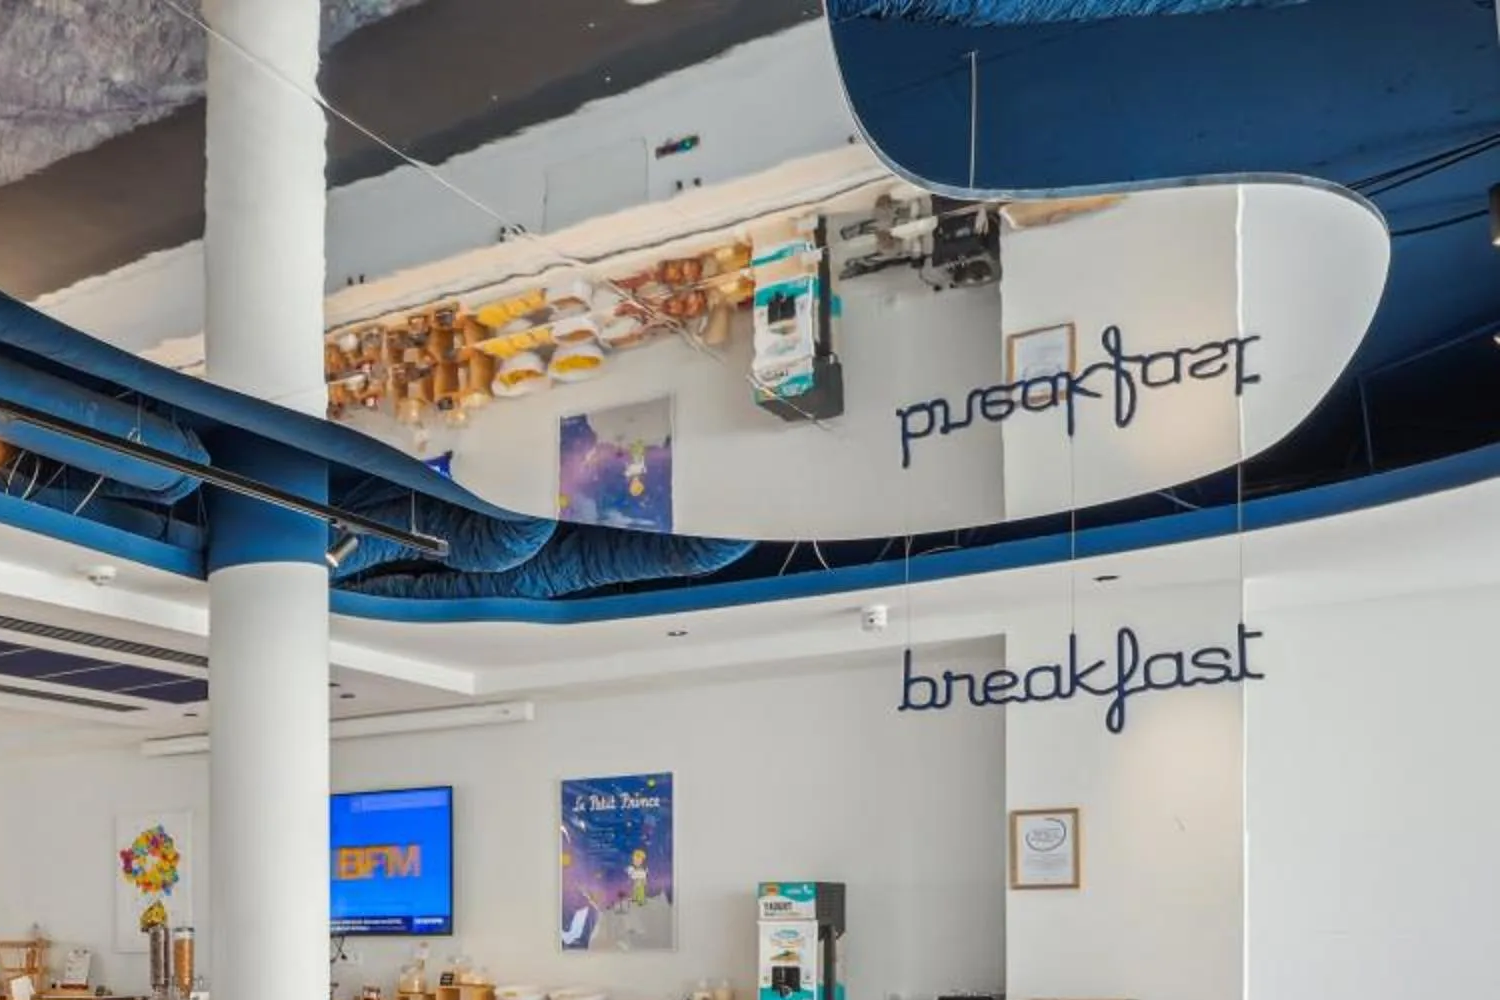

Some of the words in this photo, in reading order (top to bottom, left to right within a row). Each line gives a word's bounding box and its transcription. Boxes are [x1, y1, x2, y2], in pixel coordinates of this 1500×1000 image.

[898, 623, 1265, 733] breakfast
[589, 794, 617, 812] Petit
[620, 792, 661, 809] Prince
[338, 845, 421, 880] BFM
